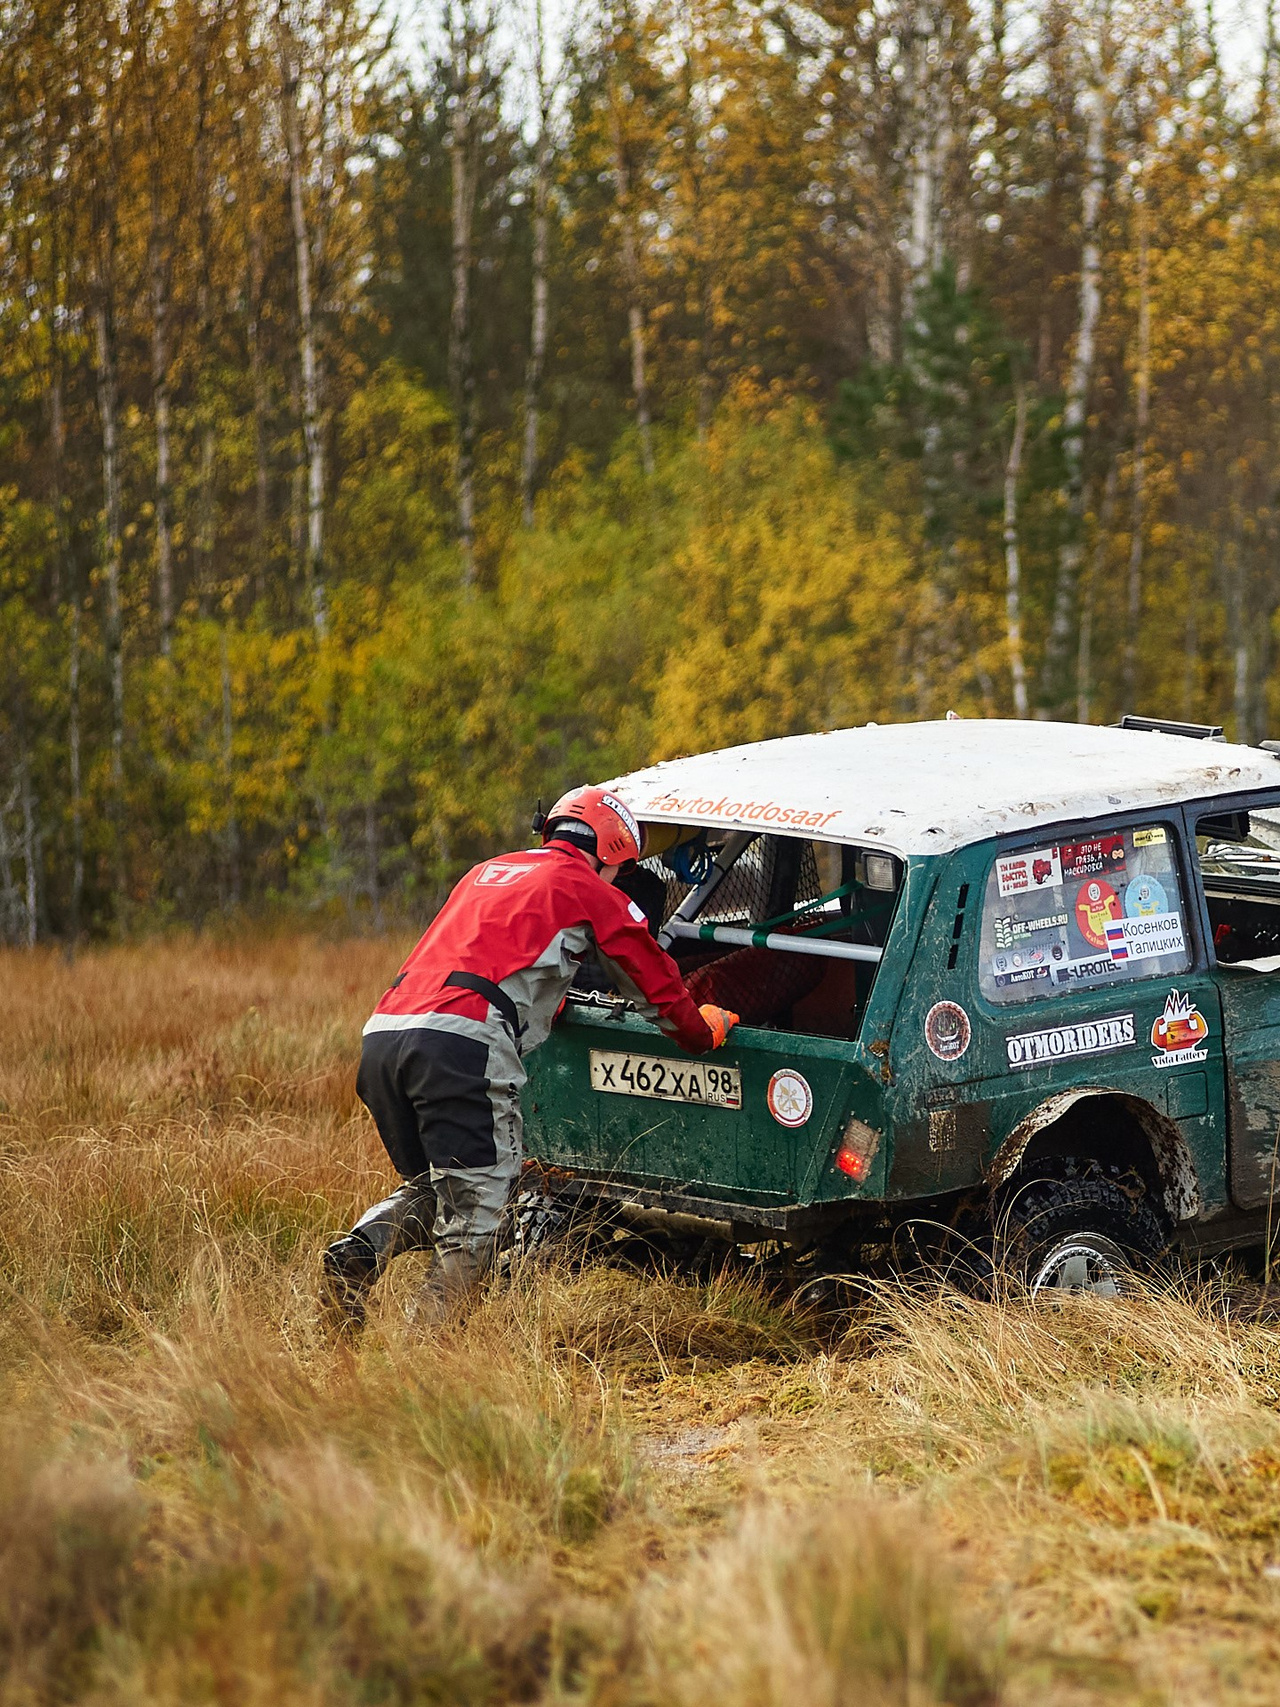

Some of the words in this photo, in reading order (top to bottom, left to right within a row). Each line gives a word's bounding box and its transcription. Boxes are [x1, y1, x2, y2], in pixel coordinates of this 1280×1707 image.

[478, 865, 533, 883] FT
[1012, 914, 1068, 934] OFF-WHEELS.RU
[1122, 919, 1179, 936] Косенков
[1126, 935, 1184, 956] Талицких
[1007, 1018, 1135, 1062] OTMORIDERS
[707, 1069, 733, 1094] 98
[708, 1092, 727, 1103] RUS
